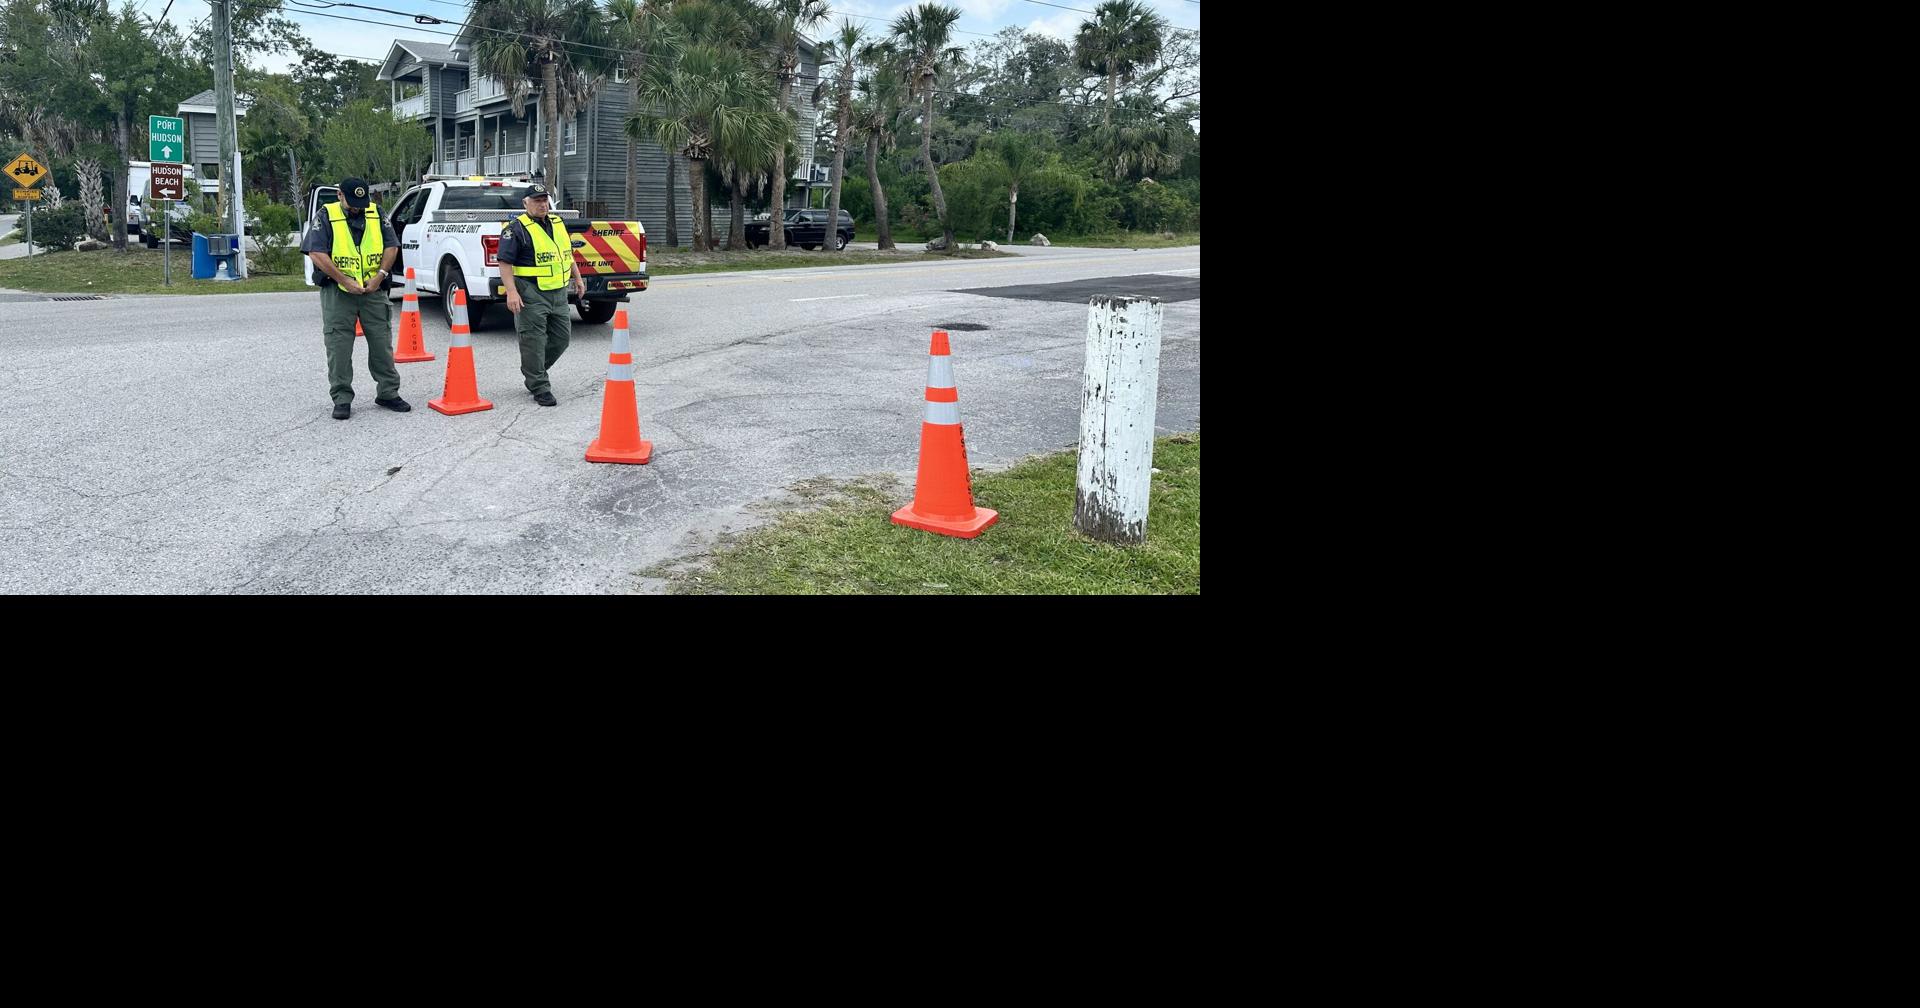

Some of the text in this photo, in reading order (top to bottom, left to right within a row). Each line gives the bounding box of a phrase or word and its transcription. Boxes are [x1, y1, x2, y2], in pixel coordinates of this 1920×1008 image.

[157, 120, 176, 130] PORT
[152, 132, 181, 143] HUDSON
[152, 166, 181, 175] HUDSON
[155, 178, 178, 186] BEACH
[428, 224, 481, 234] CITIZEN SERVICE UNIT
[592, 229, 624, 237] SHERIFF
